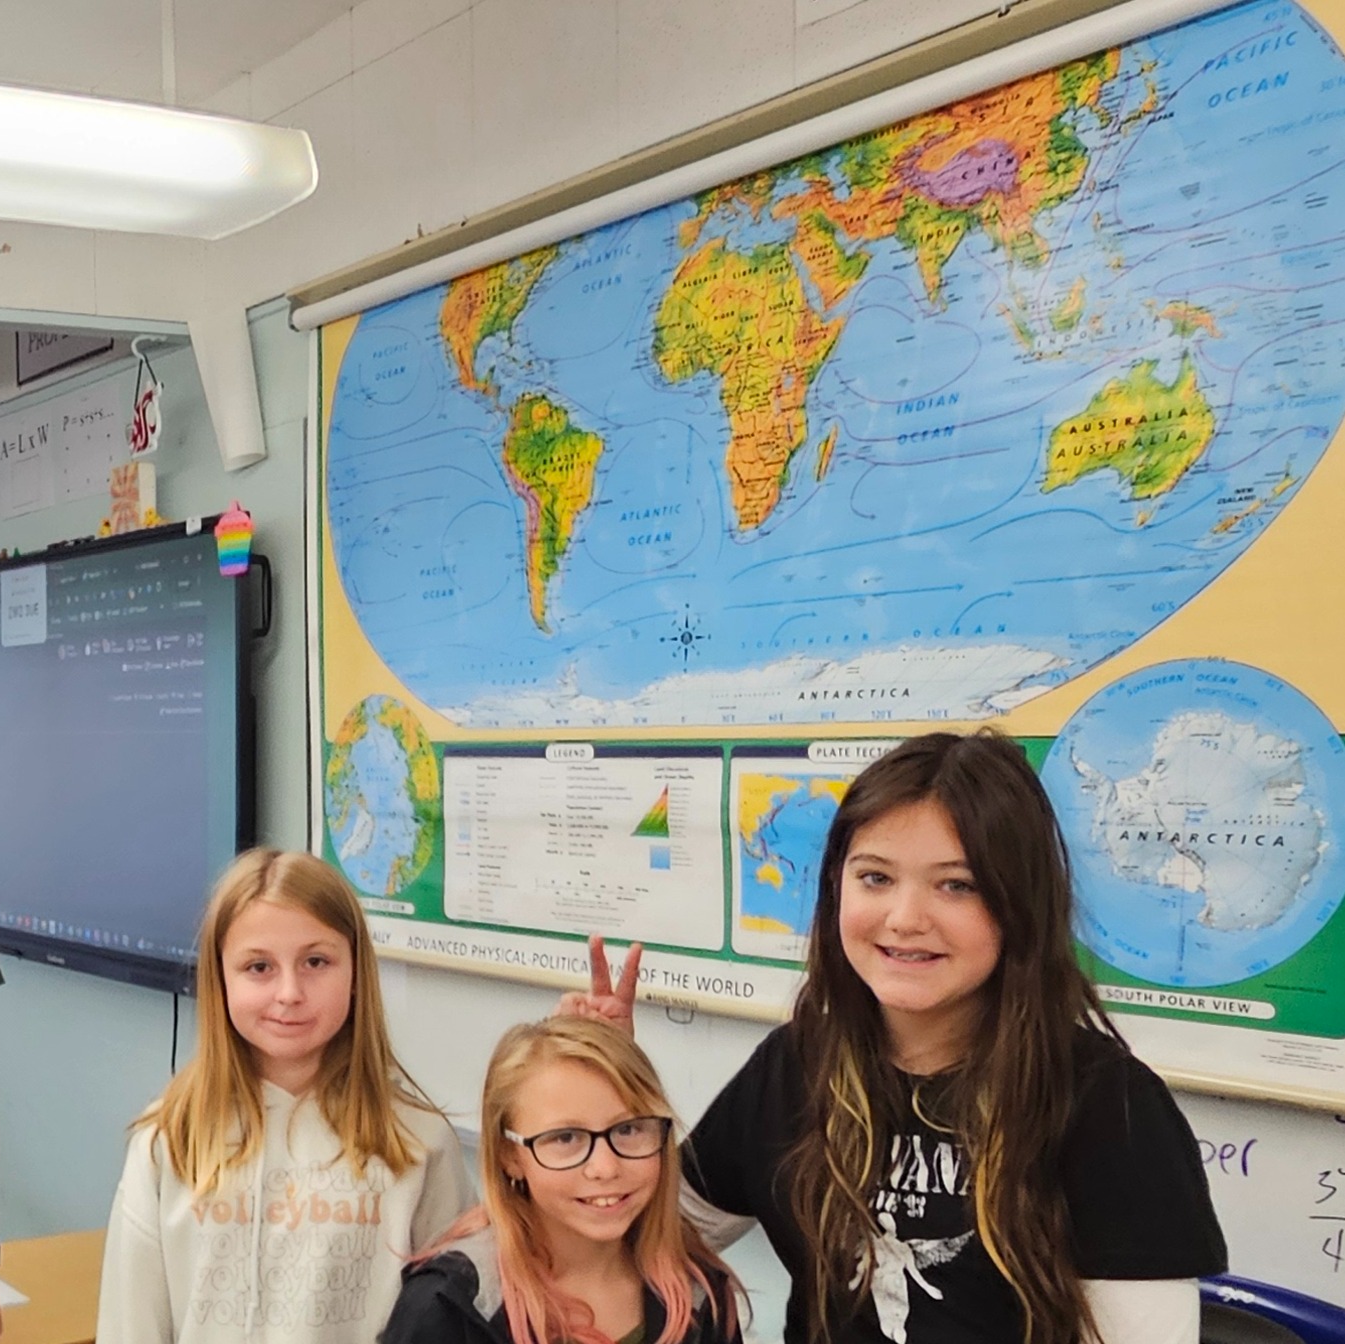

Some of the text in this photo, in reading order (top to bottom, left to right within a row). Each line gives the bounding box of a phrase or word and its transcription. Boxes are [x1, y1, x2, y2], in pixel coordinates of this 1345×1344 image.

[1208, 71, 1290, 108] OCEAN
[961, 150, 1032, 180] CHINA
[919, 224, 961, 243] INDIA
[573, 243, 632, 272] ATLANTIC
[582, 273, 623, 294] OCEAN
[375, 365, 406, 382] OCEAN
[897, 391, 961, 415] INDIAN
[1069, 406, 1190, 434] AUSTRALIA
[897, 424, 955, 445] OCEAN
[1056, 429, 1189, 460] AUSTRALIA
[620, 503, 682, 523] ATLANTIC
[628, 531, 673, 546] OCEAN
[422, 588, 455, 600] OCEAN
[913, 623, 1007, 639] OCEAN
[798, 687, 911, 701] ANTARCTICA
[1127, 673, 1185, 698] SOUTHERN
[1196, 673, 1239, 685] OCEAN
[816, 747, 850, 758] PLATE
[1119, 830, 1285, 848] ANTARCTICA
[407, 936, 468, 957] ADVANCED
[471, 944, 589, 974] PHYSICAL-POLITICA
[639, 967, 657, 983] OF
[663, 970, 690, 990] THE
[696, 976, 755, 998] WORLD
[1106, 989, 1252, 1014] SOUTH POLAR VIEW
[191, 1191, 382, 1232] voleyball
